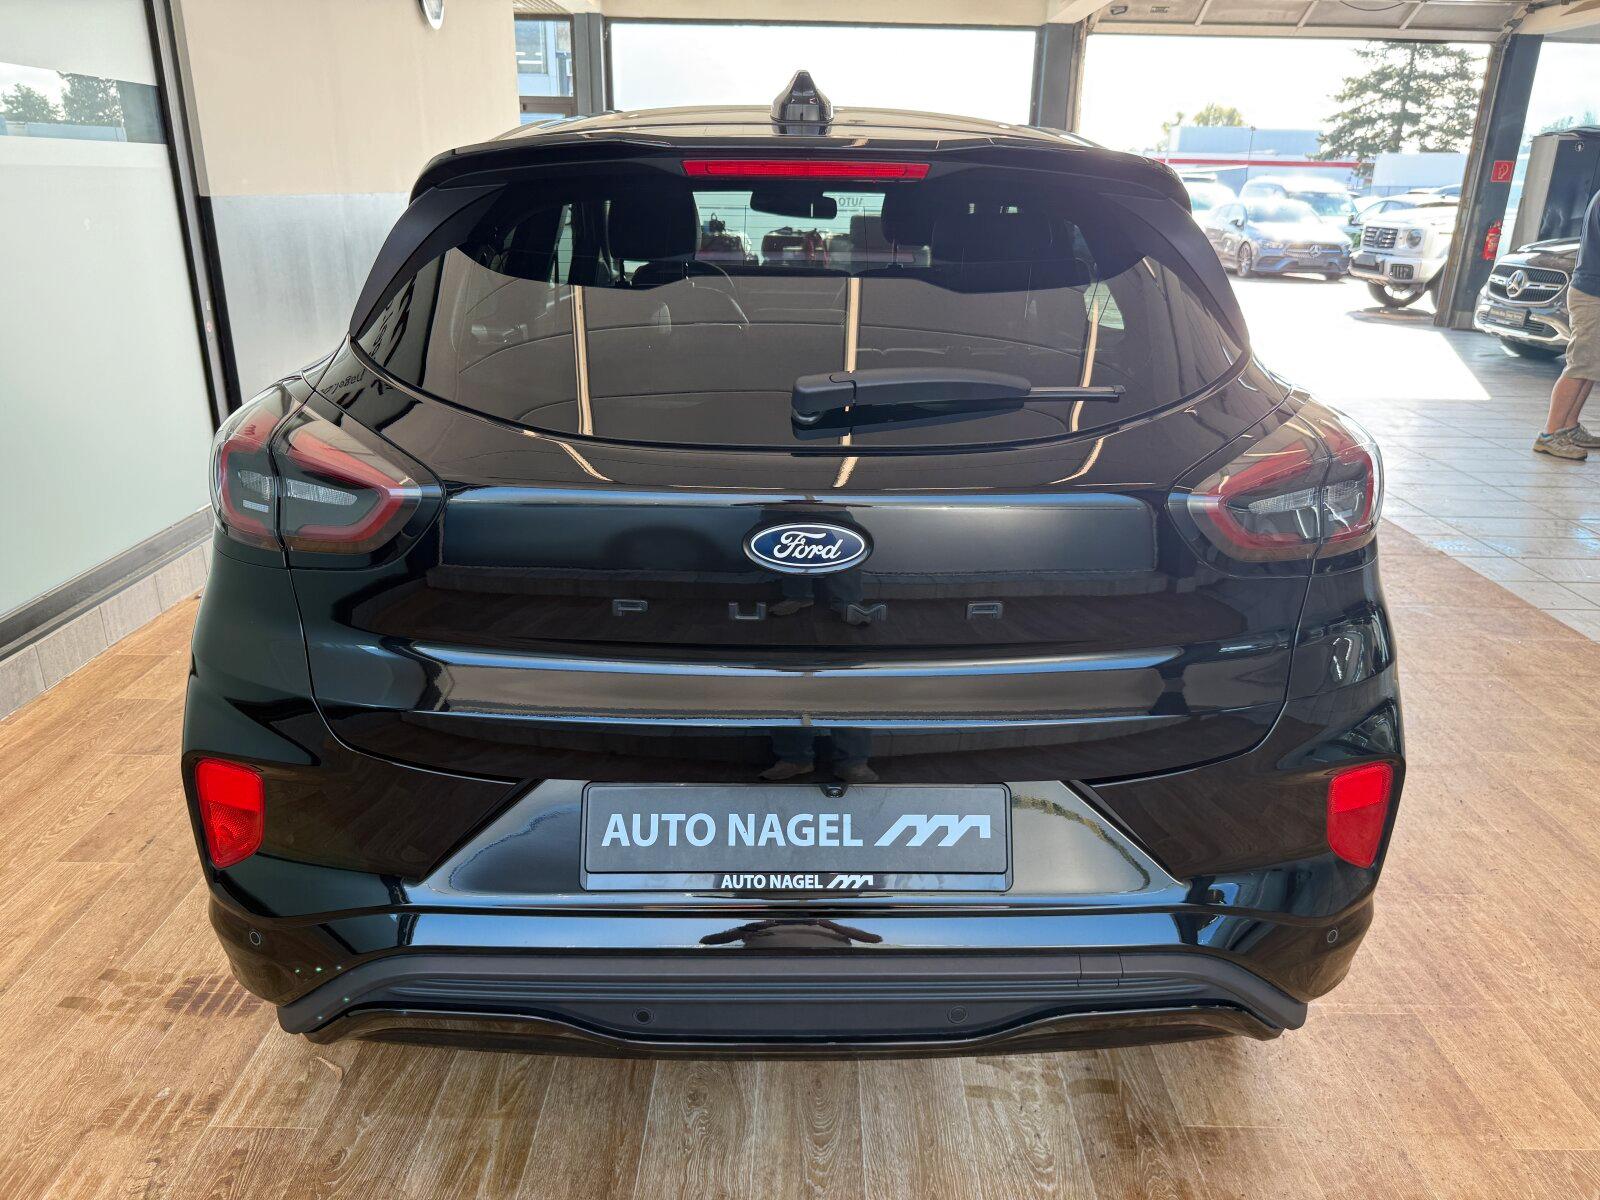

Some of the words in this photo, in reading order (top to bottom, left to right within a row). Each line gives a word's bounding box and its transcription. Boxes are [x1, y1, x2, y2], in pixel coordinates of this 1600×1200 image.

[773, 531, 843, 558] Ford
[601, 813, 716, 847] AUTO
[728, 813, 863, 847] NAGEL
[721, 874, 766, 889] AUTO
[769, 874, 823, 889] NAGEL
